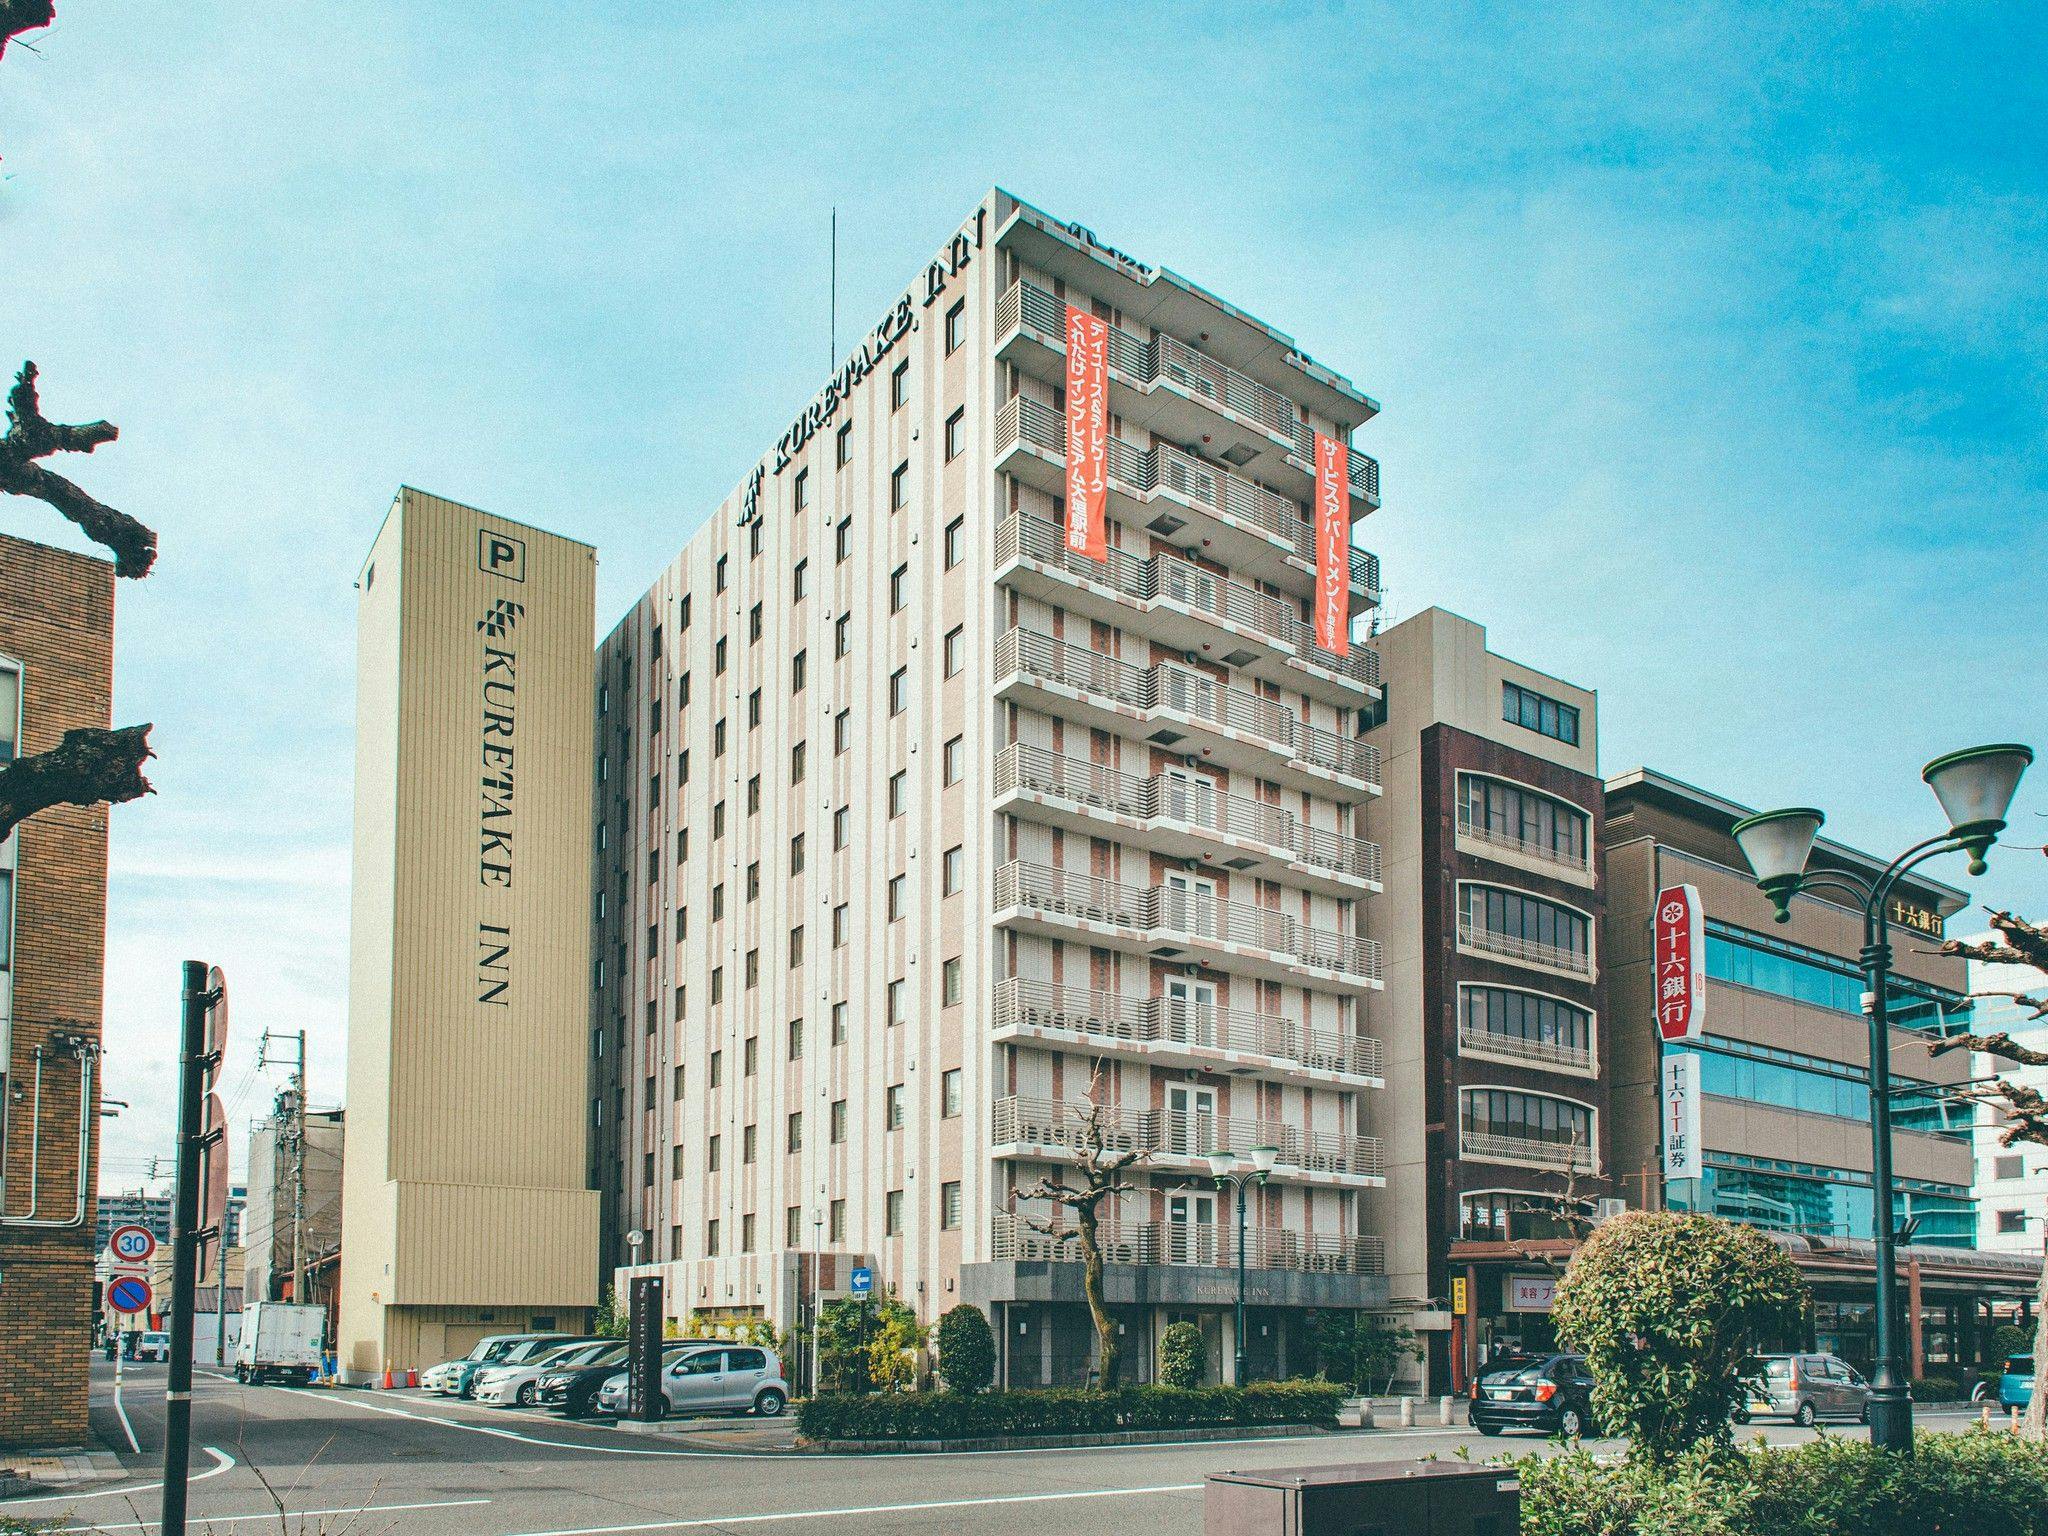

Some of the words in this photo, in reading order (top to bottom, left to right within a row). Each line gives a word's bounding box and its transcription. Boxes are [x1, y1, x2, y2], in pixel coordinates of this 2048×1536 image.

[773, 293, 914, 476] KURETAKE
[923, 207, 987, 308] INN
[490, 540, 514, 568] P
[479, 645, 516, 889] KURETAKE
[1893, 900, 1943, 936] 十六銀行
[478, 921, 510, 1008] INN
[1661, 926, 1688, 1025] 十六銀行
[1667, 1064, 1686, 1168] 十六TT証券
[120, 1234, 146, 1253] 30
[1519, 1286, 1538, 1300] 美容
